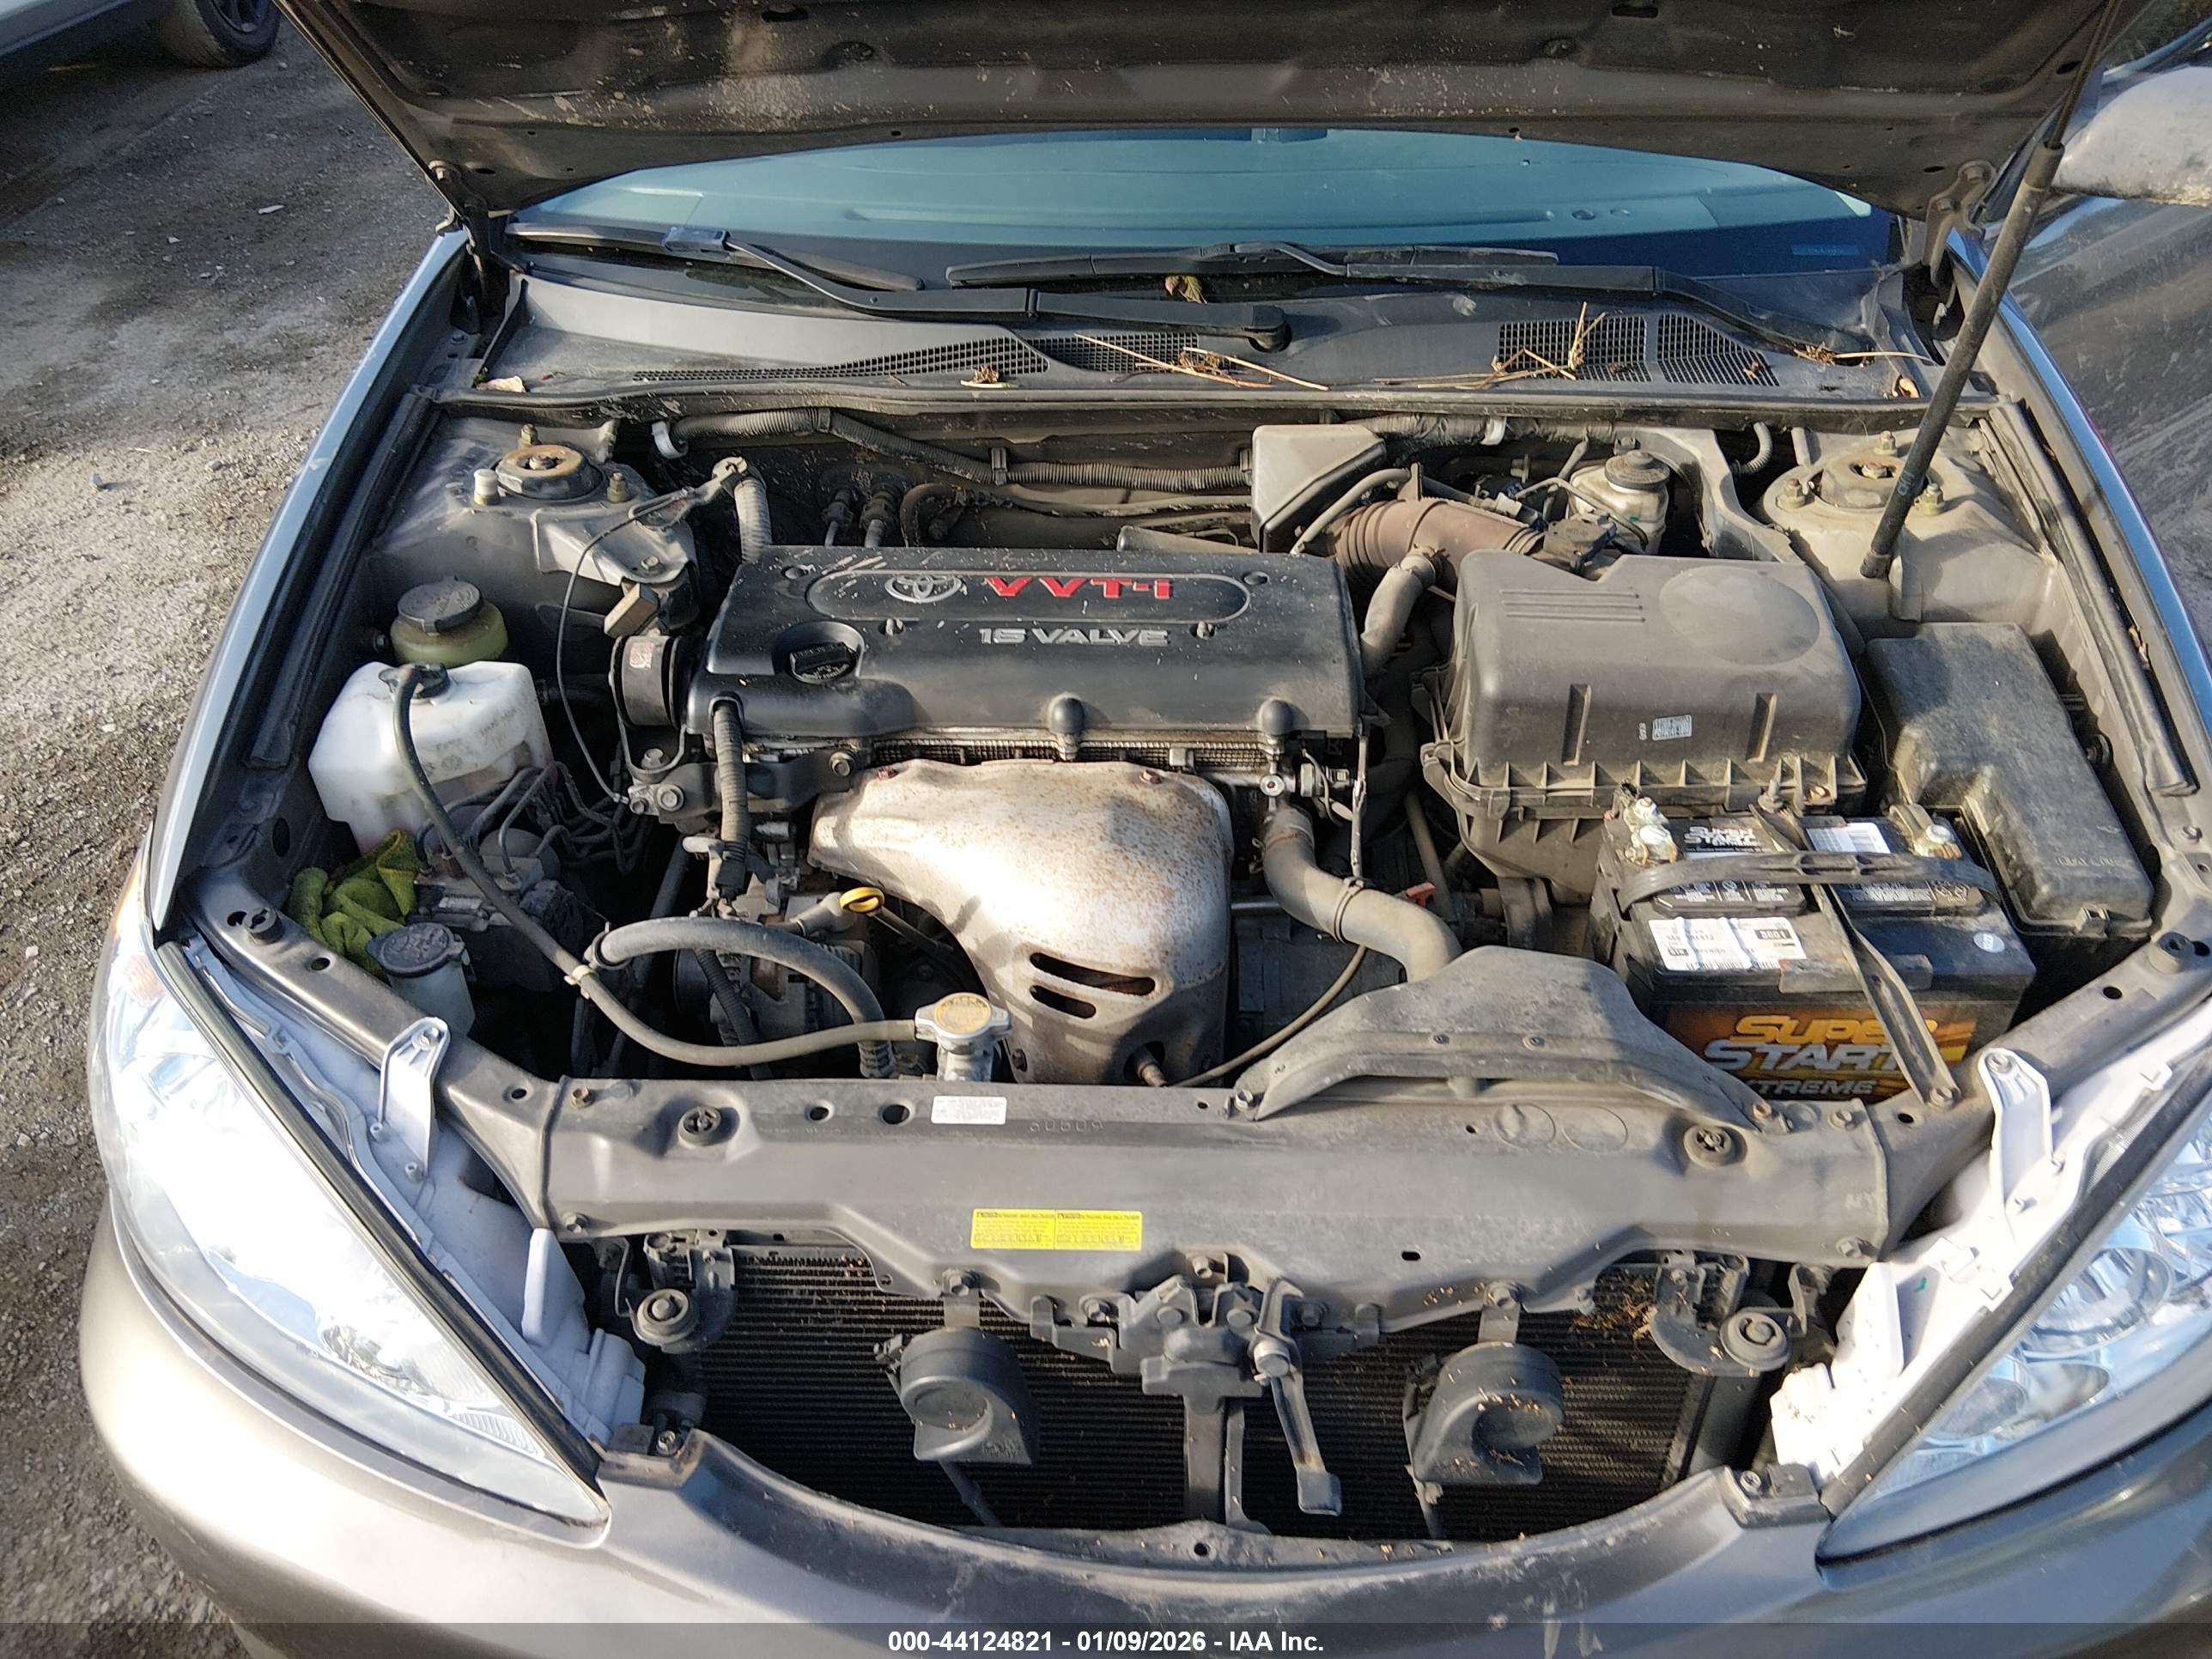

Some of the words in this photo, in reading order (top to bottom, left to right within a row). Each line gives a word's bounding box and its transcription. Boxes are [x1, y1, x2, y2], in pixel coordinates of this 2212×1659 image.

[979, 628, 1027, 644] 16
[1031, 628, 1170, 646] VALVE
[1729, 1014, 1938, 1045] SUPE
[1746, 1079, 1878, 1096] TREME
